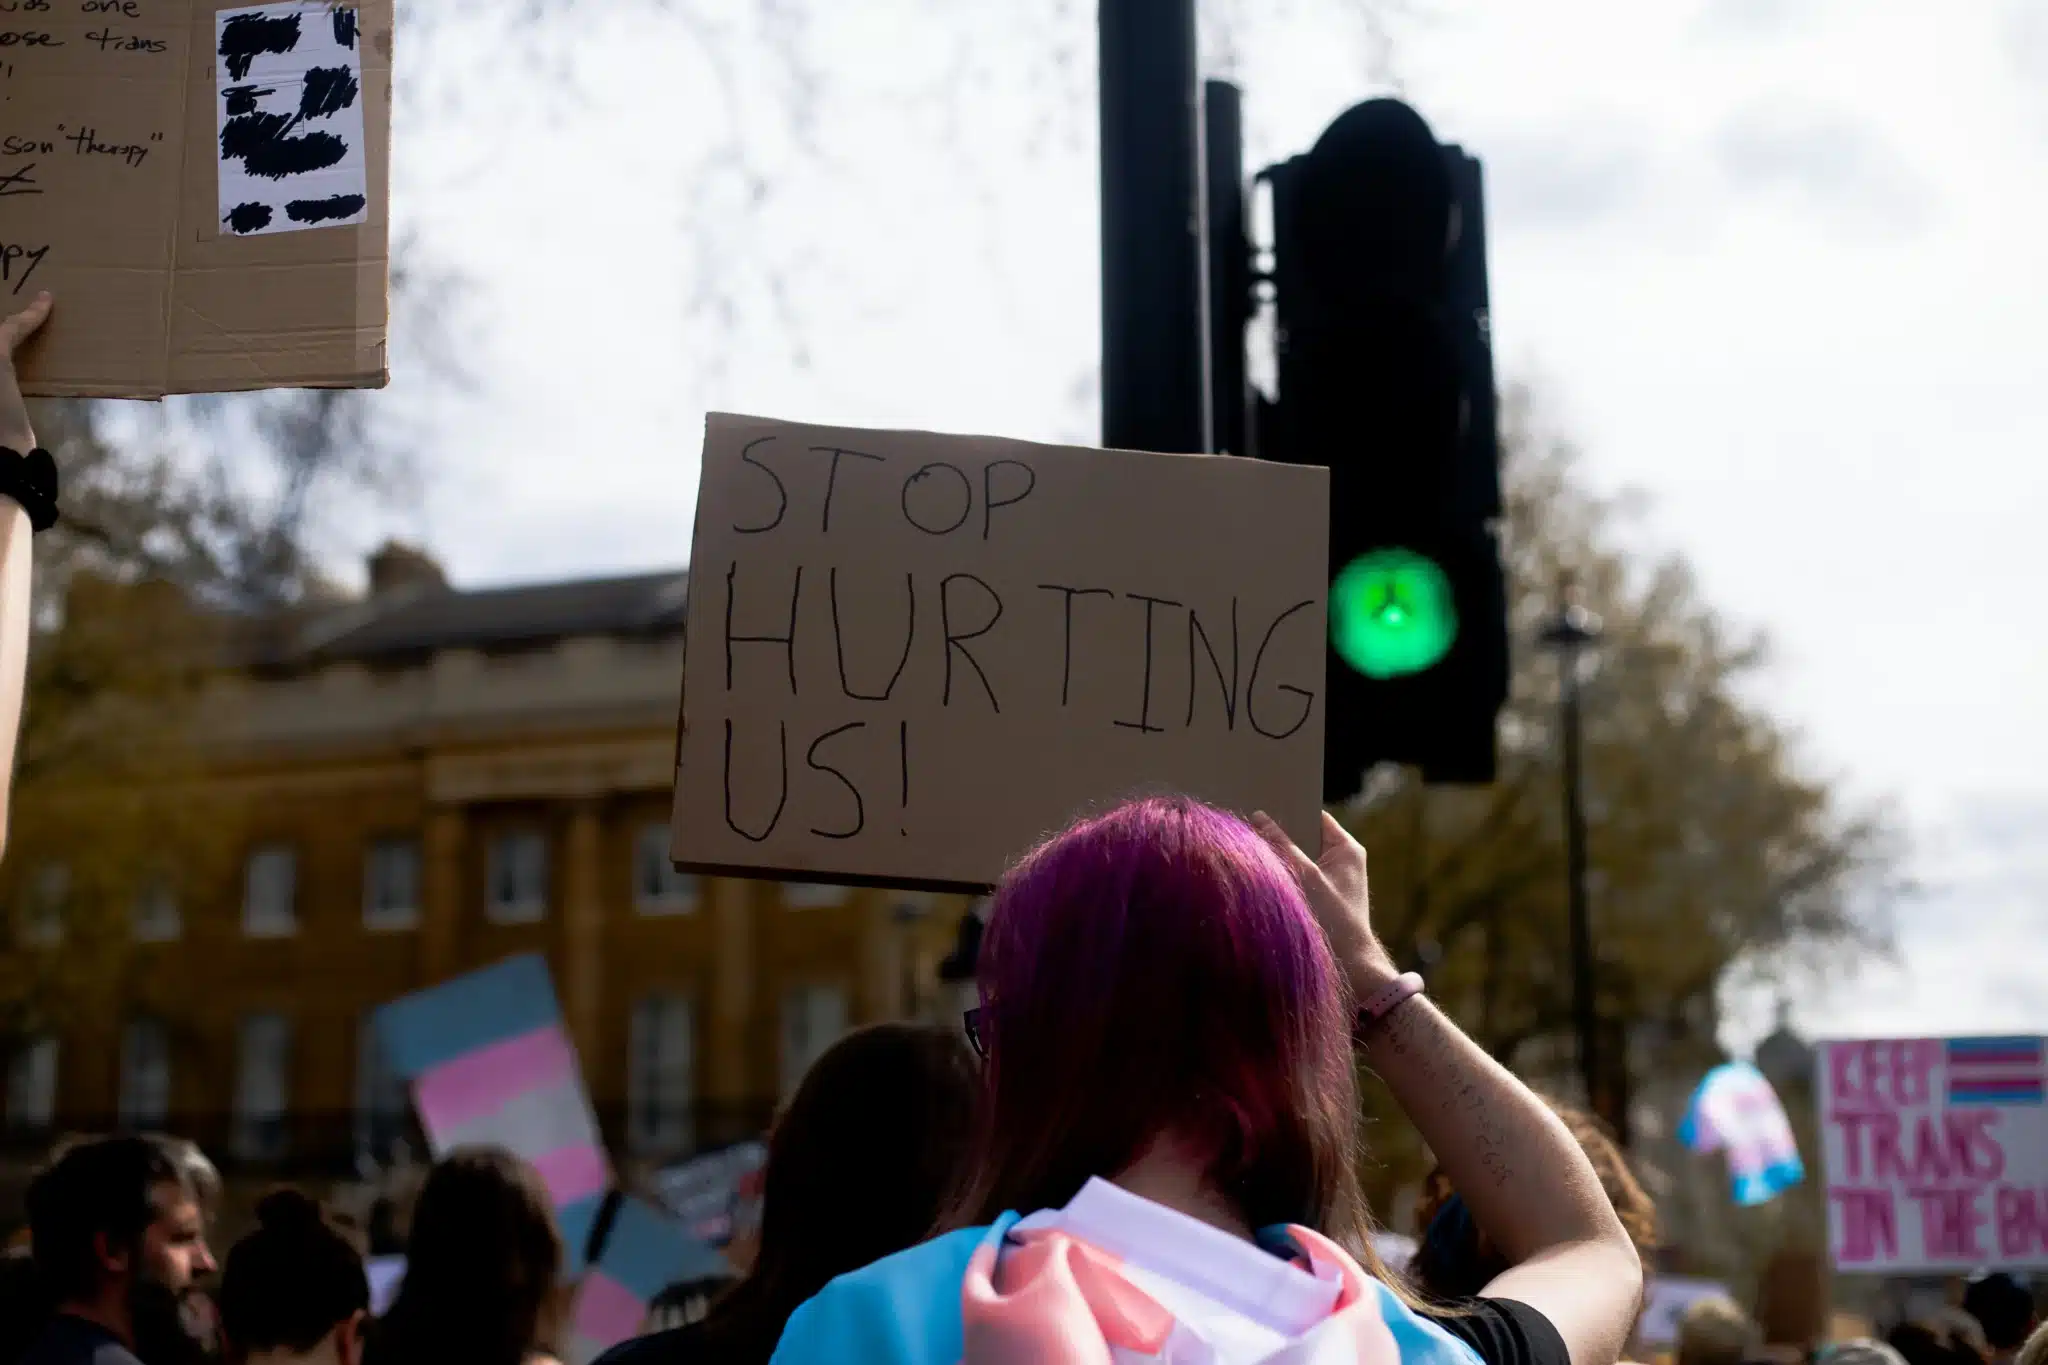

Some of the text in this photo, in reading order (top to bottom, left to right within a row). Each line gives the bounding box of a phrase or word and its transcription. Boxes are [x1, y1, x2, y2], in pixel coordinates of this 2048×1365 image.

[81, 0, 141, 18] one
[85, 28, 167, 52] trans
[732, 436, 1036, 541] STOP
[725, 560, 1315, 740] HURTING
[724, 717, 910, 842] US!
[1830, 1109, 2005, 1182] TRANS
[1829, 1187, 1900, 1262] IN
[1907, 1187, 1986, 1261] THE
